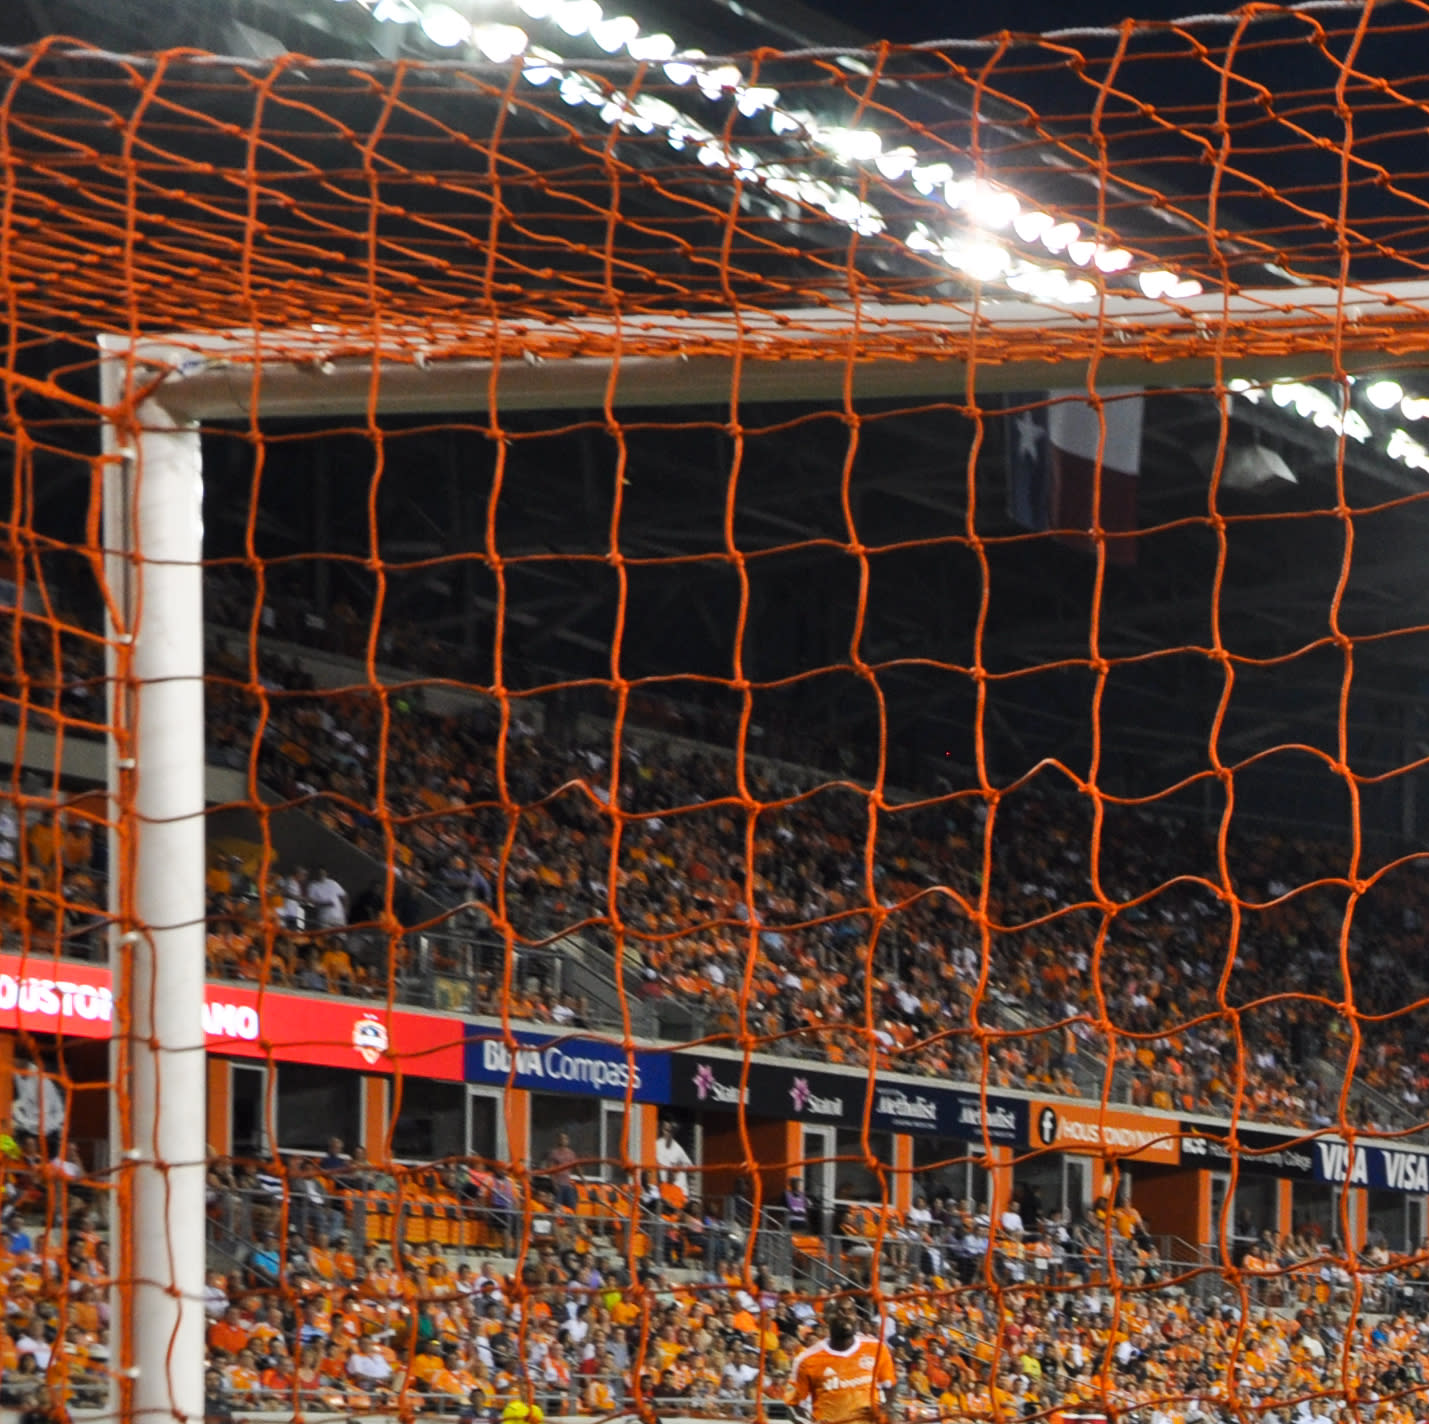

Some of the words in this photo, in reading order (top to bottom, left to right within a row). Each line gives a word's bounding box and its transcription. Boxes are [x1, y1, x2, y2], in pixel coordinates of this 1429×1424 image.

[545, 1046, 642, 1089] Compass
[1319, 1142, 1368, 1184] VISA
[1382, 1151, 1429, 1192] VISA
